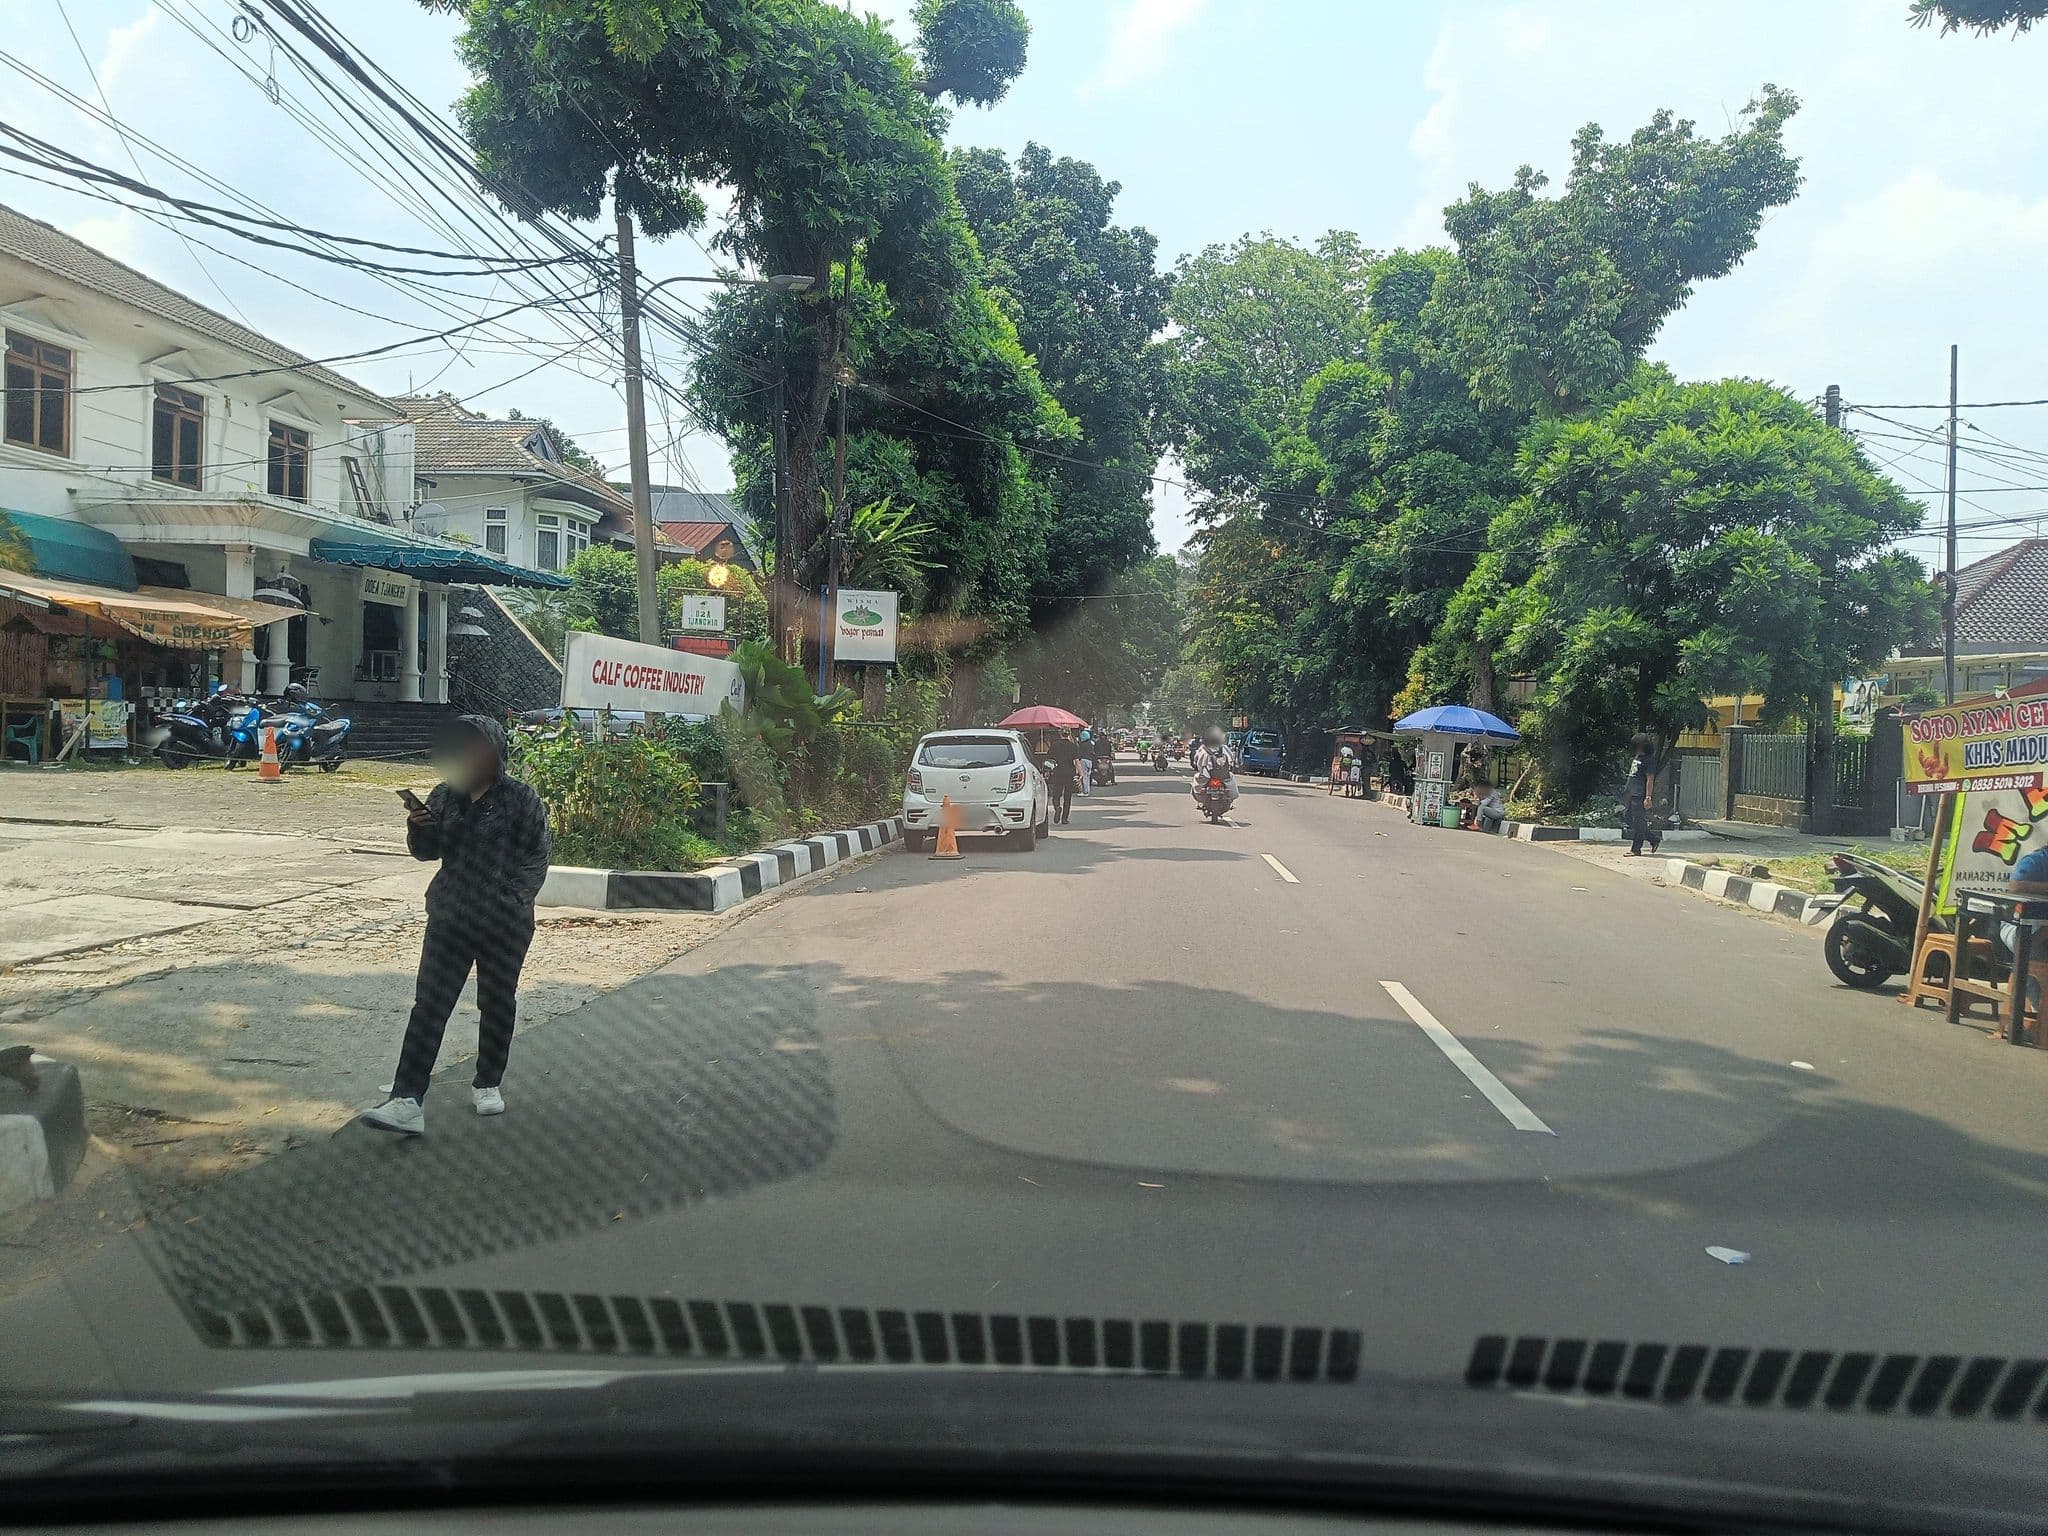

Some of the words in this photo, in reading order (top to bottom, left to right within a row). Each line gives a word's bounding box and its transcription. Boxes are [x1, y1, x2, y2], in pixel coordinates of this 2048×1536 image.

[381, 582, 406, 599] TJANGKIR
[592, 659, 622, 686] CALF
[623, 664, 663, 691] COFFEE
[663, 670, 706, 696] INDUSTRY
[1910, 714, 1958, 743] SOTO
[1960, 704, 2015, 739] AYAM
[1964, 739, 2003, 769] KHAS
[1971, 780, 1993, 791] 0838
[2013, 776, 2035, 788] 3012
